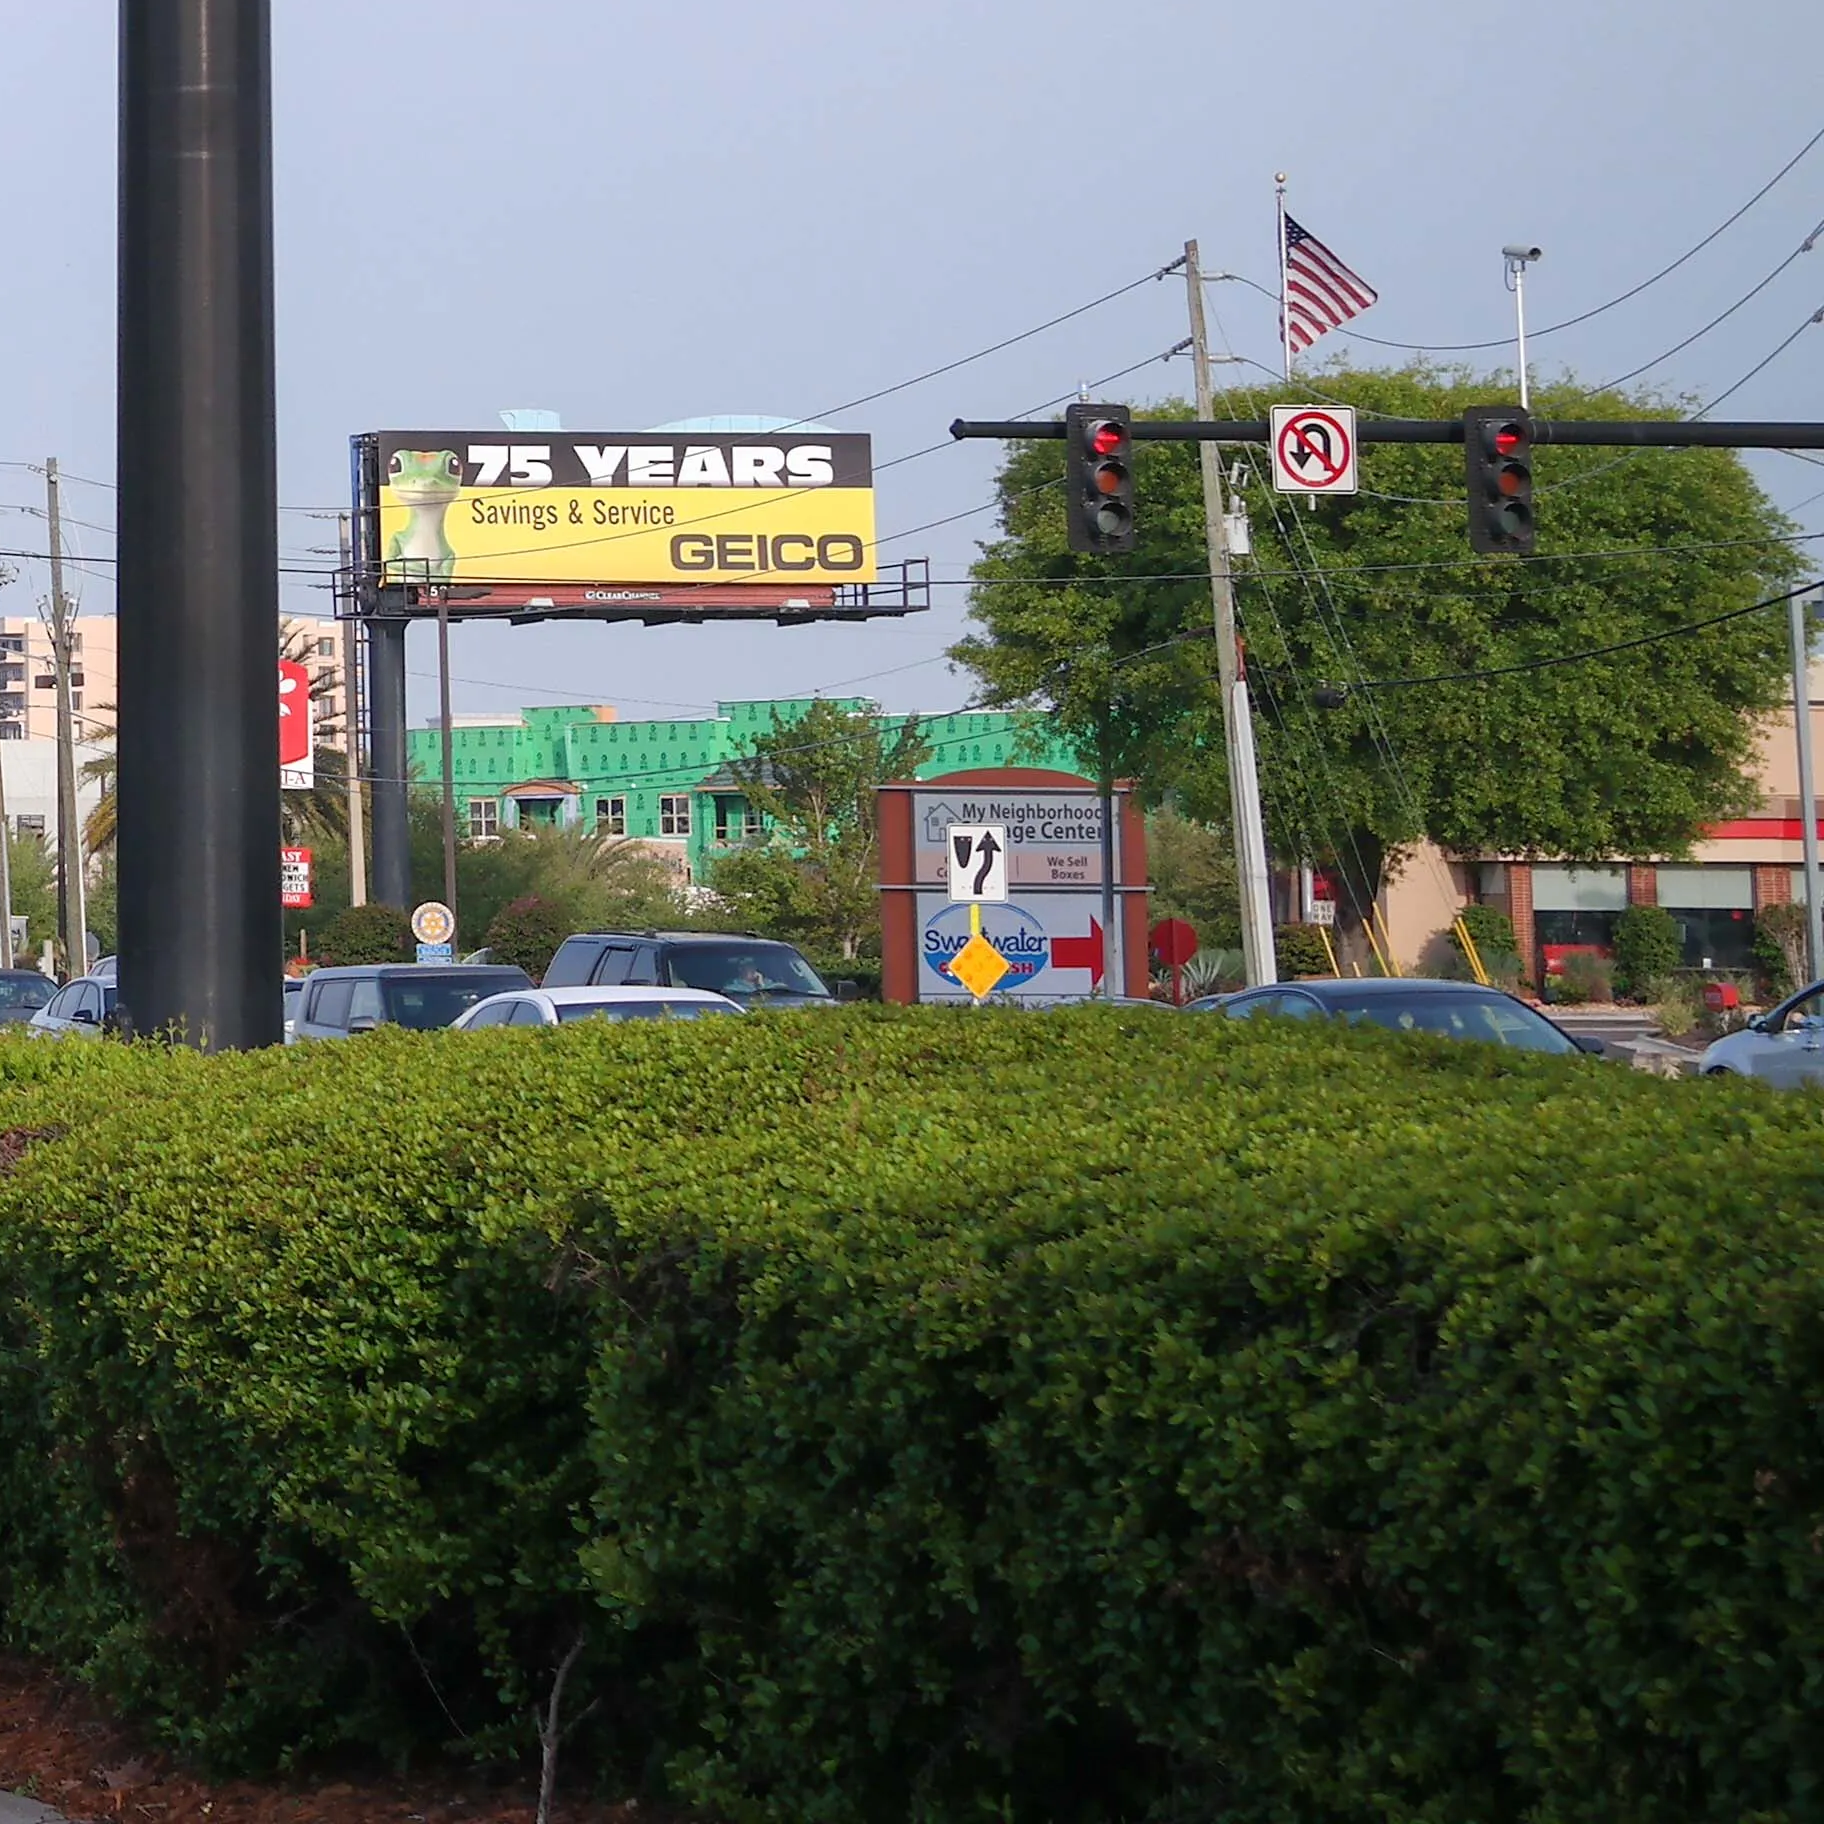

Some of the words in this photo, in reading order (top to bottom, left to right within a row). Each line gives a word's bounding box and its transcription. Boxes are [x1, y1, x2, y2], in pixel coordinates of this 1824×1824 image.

[467, 445, 553, 488] 75
[572, 445, 835, 489] YEARS
[472, 498, 558, 530] Savings
[568, 500, 583, 525] &
[592, 499, 675, 525] Service
[669, 534, 864, 571] GEICO
[962, 803, 986, 824] My
[1046, 856, 1065, 867] We
[1067, 856, 1088, 867] Sell
[1051, 869, 1086, 880] Boxes
